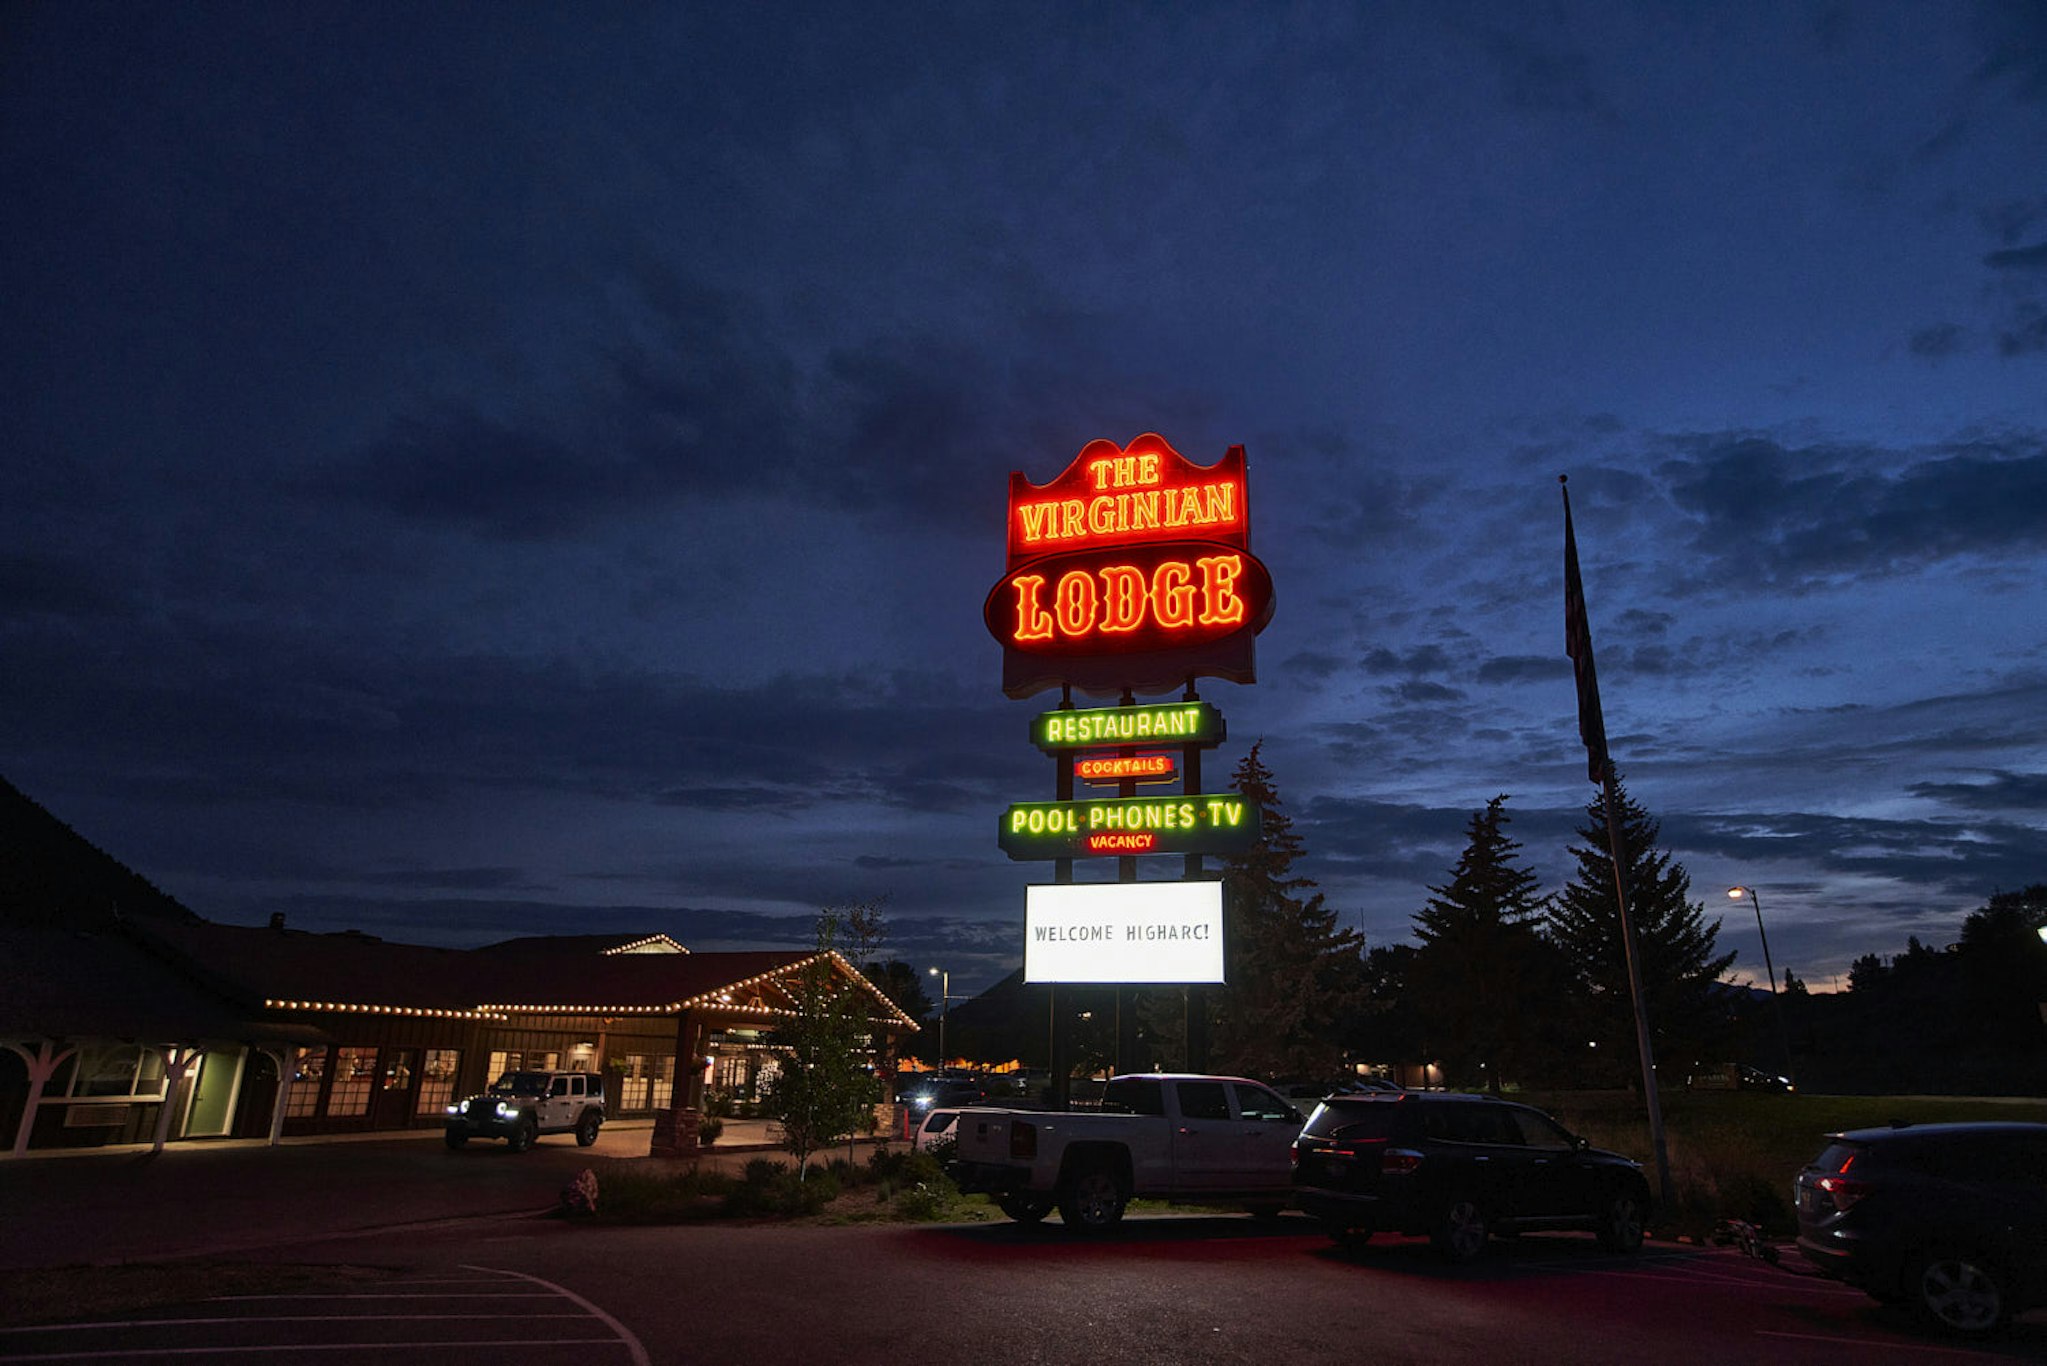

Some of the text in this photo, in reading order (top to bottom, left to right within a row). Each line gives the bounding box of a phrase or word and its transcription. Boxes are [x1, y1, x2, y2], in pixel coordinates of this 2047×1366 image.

[1090, 454, 1160, 489] THE
[1018, 482, 1235, 542] VIRGINIAN
[1012, 555, 1244, 640] LODGE
[1047, 709, 1200, 742] RESTAURANT
[1081, 757, 1166, 775] COCKTAILS
[1012, 802, 1243, 833] POOL PHONES TV
[1090, 834, 1153, 849] VACANCY
[1034, 923, 1210, 942] WELCOME HIGHARC!
